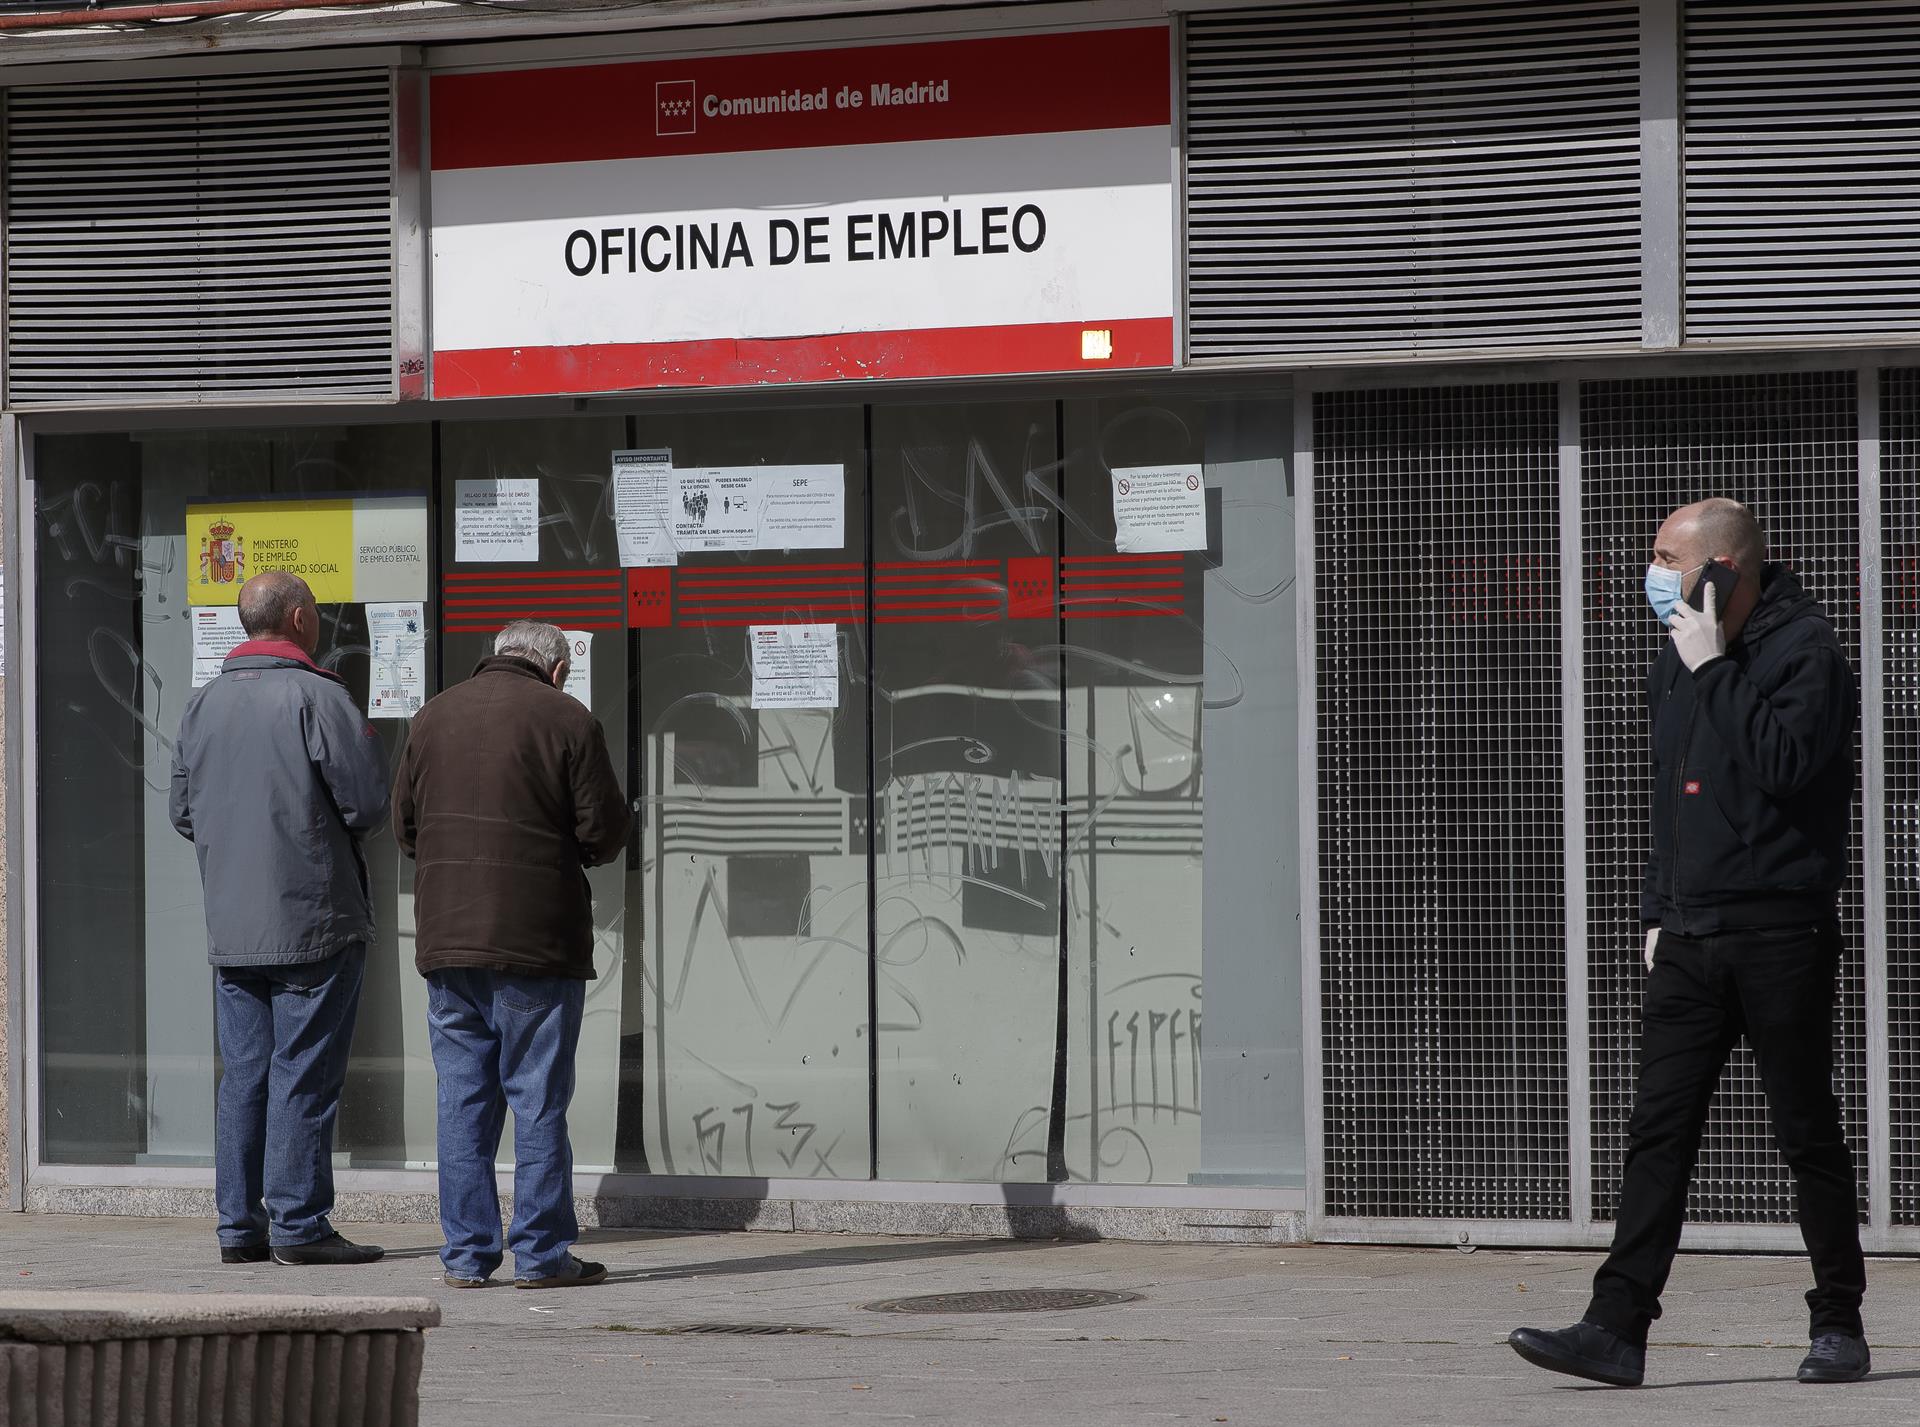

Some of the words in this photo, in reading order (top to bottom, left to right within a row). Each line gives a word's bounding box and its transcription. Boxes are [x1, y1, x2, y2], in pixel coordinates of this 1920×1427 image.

[703, 87, 828, 118] Comunidad
[835, 86, 863, 109] de
[870, 79, 949, 107] Madrid
[564, 221, 754, 277] OFICINA
[769, 216, 831, 266] DE
[847, 203, 1047, 262] EMPLEO
[792, 478, 808, 487] SEPE
[252, 538, 299, 550] MINISTERIO
[359, 545, 388, 554] SERVICIO
[389, 543, 417, 553] PÚBLICO
[252, 552, 265, 563] DE
[266, 551, 298, 562] EMPLEO
[359, 555, 369, 564] DE
[370, 554, 395, 563] EMPLEO
[395, 553, 421, 563] ESTATAL
[252, 565, 259, 575] Y
[309, 563, 339, 574] SOCIAL
[370, 610, 395, 618] Coronavirus
[398, 609, 418, 617] COVID-19
